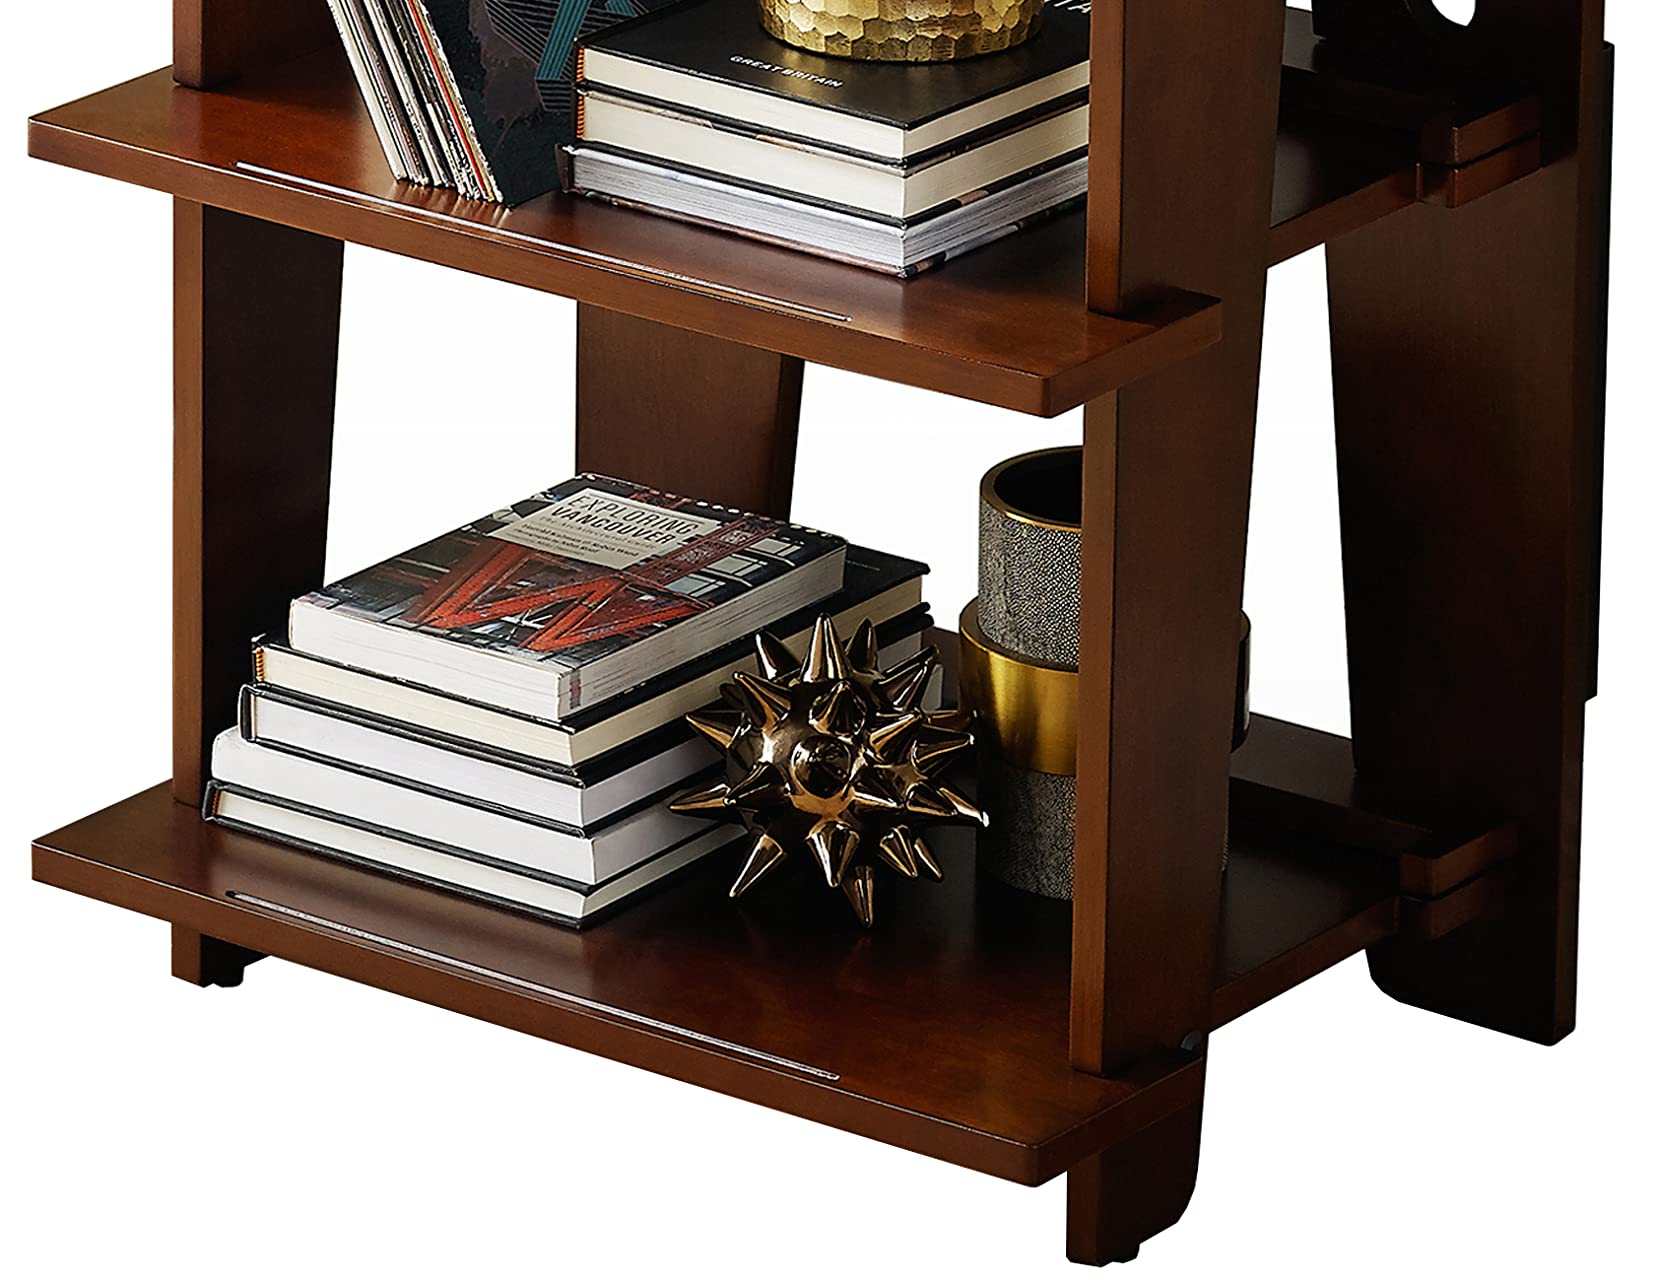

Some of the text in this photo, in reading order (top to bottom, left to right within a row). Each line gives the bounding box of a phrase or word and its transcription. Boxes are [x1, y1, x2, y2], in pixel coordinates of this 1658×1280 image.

[730, 55, 843, 88] GREAT BRITAIN
[551, 506, 677, 545] VANCOUVER
[568, 495, 700, 536] EXPLORING
